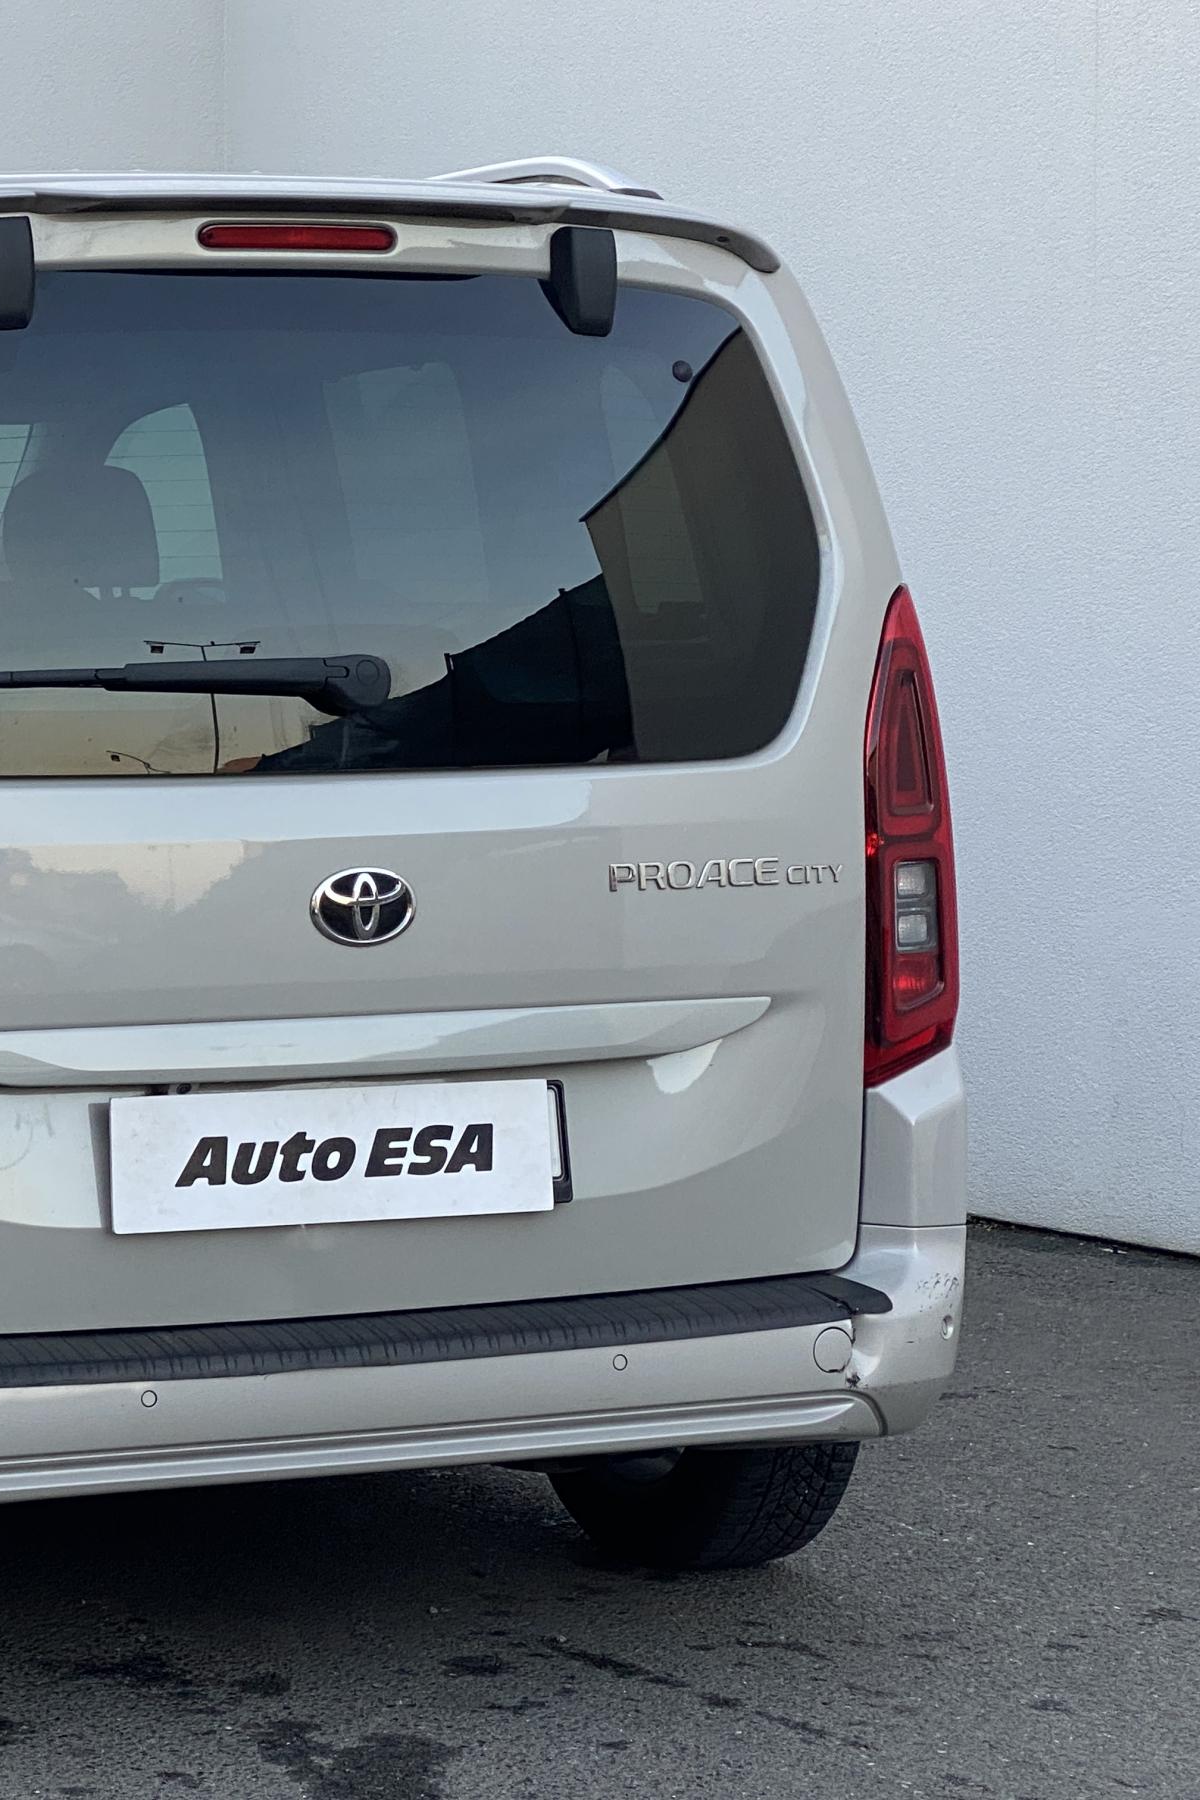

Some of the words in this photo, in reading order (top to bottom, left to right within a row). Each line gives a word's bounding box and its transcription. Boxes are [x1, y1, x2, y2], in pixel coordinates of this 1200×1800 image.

[608, 856, 780, 892] PROACE
[785, 863, 843, 886] CITY
[174, 1131, 357, 1188] Auto
[364, 1122, 494, 1178] ESA
